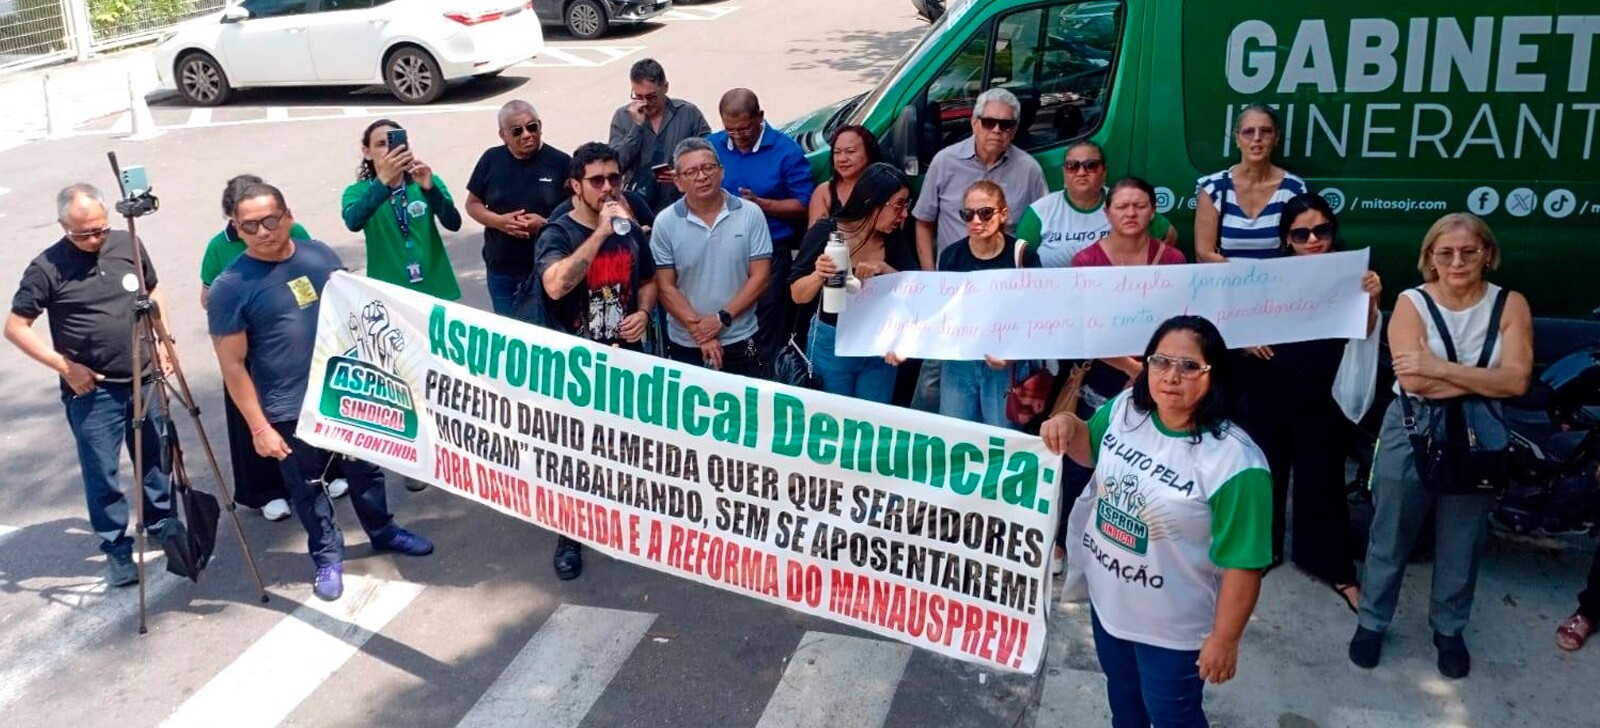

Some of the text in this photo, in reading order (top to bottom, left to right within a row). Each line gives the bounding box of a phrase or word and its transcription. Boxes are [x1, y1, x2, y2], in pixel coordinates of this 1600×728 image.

[1226, 15, 1600, 95] GABINET
[1223, 102, 1600, 161] IINERANT
[1361, 197, 1448, 212] mitosojr.com
[1065, 231, 1096, 242] LUTO
[989, 270, 1060, 291] mulher
[1111, 269, 1174, 299] dupla
[990, 320, 1018, 342] que
[1026, 316, 1075, 340] pagar
[331, 362, 413, 410] ASPROM
[428, 303, 1055, 515] AspromSindical Denuncia:
[340, 396, 405, 432] SINDICAL
[354, 432, 418, 463] CONTINUA
[426, 368, 1045, 569] PREFEITO DAVID ALMEIDA QUER QUE SERVIDORES
[1114, 443, 1153, 471] LUTO
[1150, 464, 1195, 497] PELA
[434, 443, 1030, 670] FORA DAVID ALMEIDA E A REFORMA DO MANAUSPREV!
[533, 446, 709, 529] TRABALHANDO,
[715, 496, 771, 542] SEM
[775, 510, 809, 553] SE
[810, 522, 1040, 616] APOSENTAREM!
[1082, 532, 1164, 589] EDUCAÇÃO
